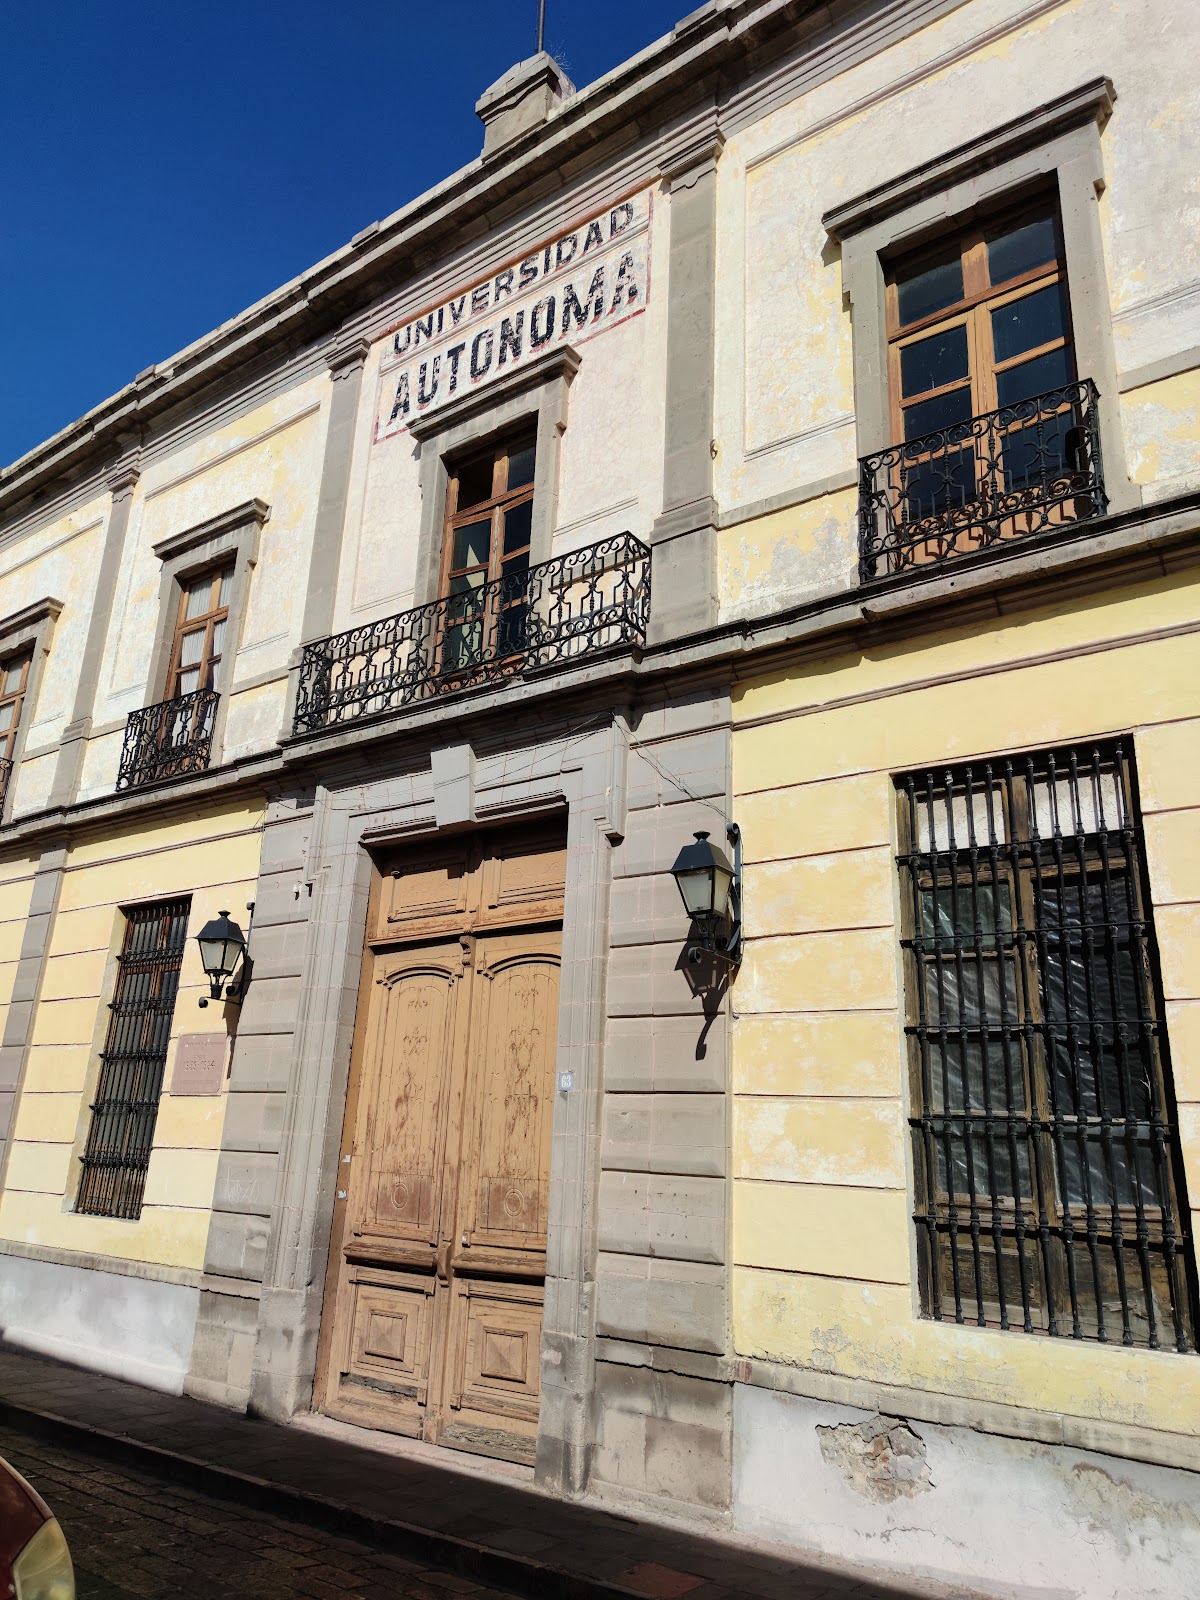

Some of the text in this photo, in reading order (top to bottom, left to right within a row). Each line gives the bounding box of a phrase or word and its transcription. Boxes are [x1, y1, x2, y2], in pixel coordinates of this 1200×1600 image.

[388, 251, 640, 424] AUTONOMA
[393, 202, 635, 357] UNIVERSIDAD
[561, 1075, 572, 1088] 63
